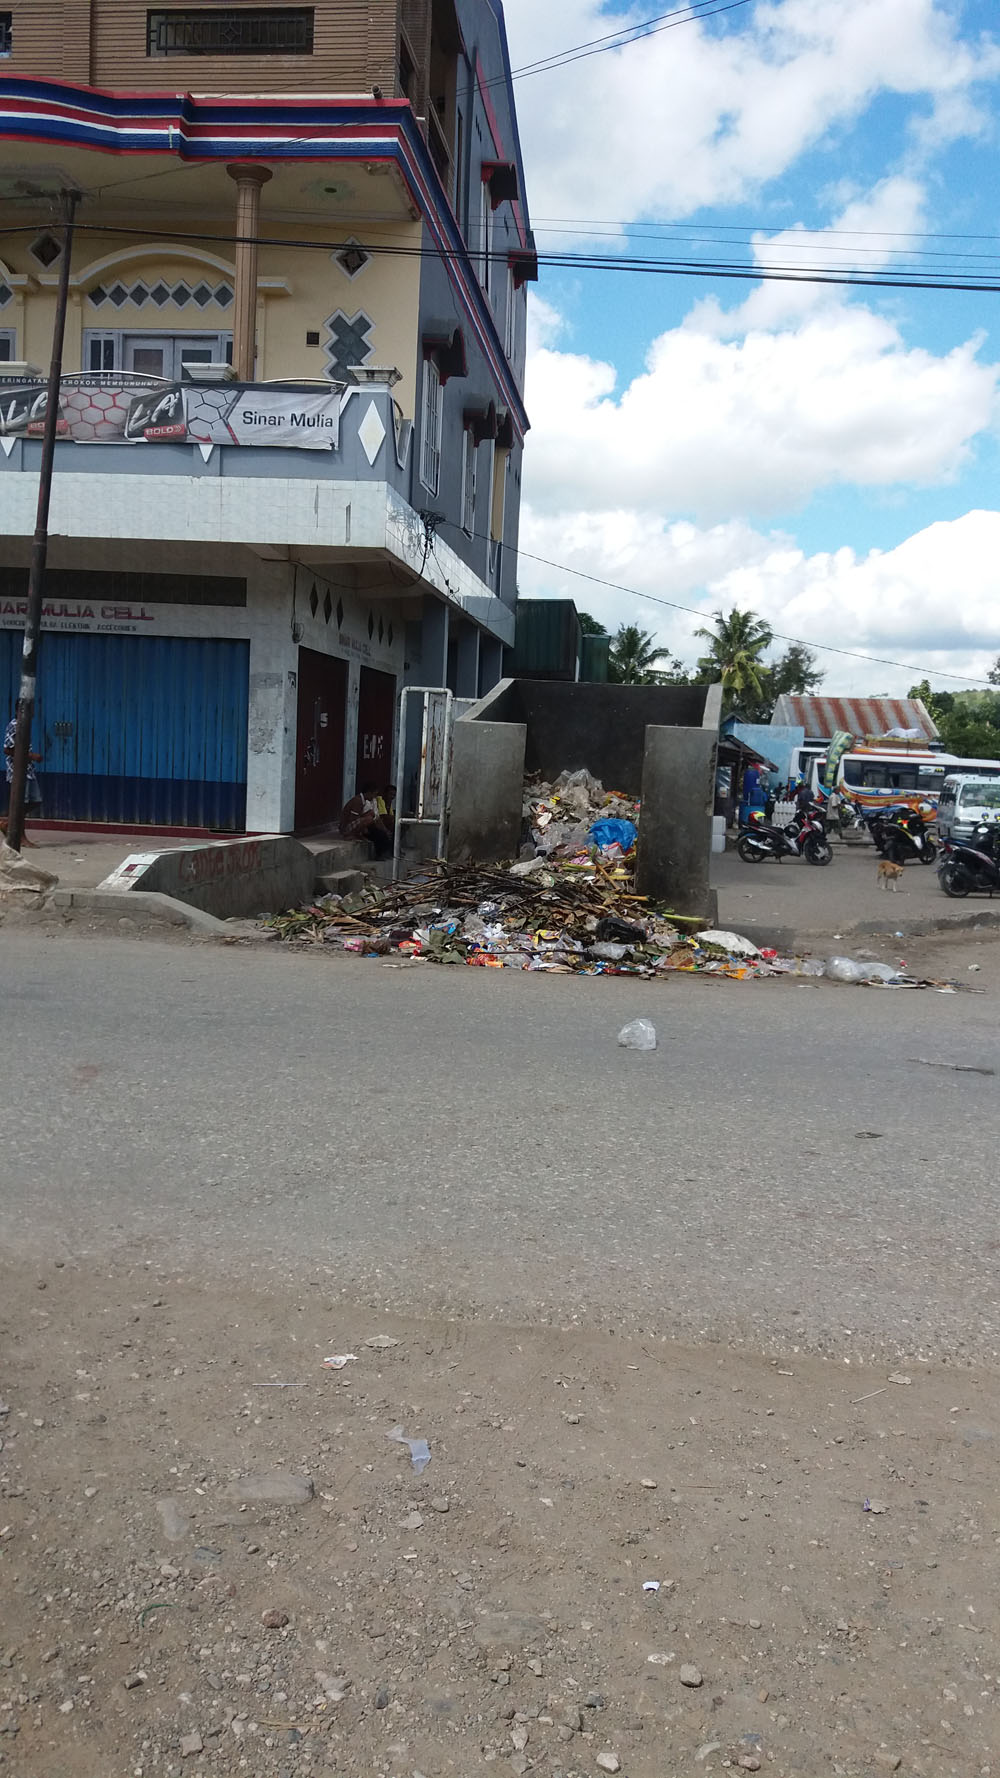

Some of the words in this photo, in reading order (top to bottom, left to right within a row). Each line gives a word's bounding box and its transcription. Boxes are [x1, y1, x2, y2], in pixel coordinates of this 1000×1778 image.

[0, 377, 49, 385] ERINGATAN
[242, 410, 286, 427] Sinar
[290, 412, 334, 429] Mulia
[145, 426, 175, 436] BOLD
[40, 602, 96, 619] MULIA
[101, 606, 155, 621] CELL
